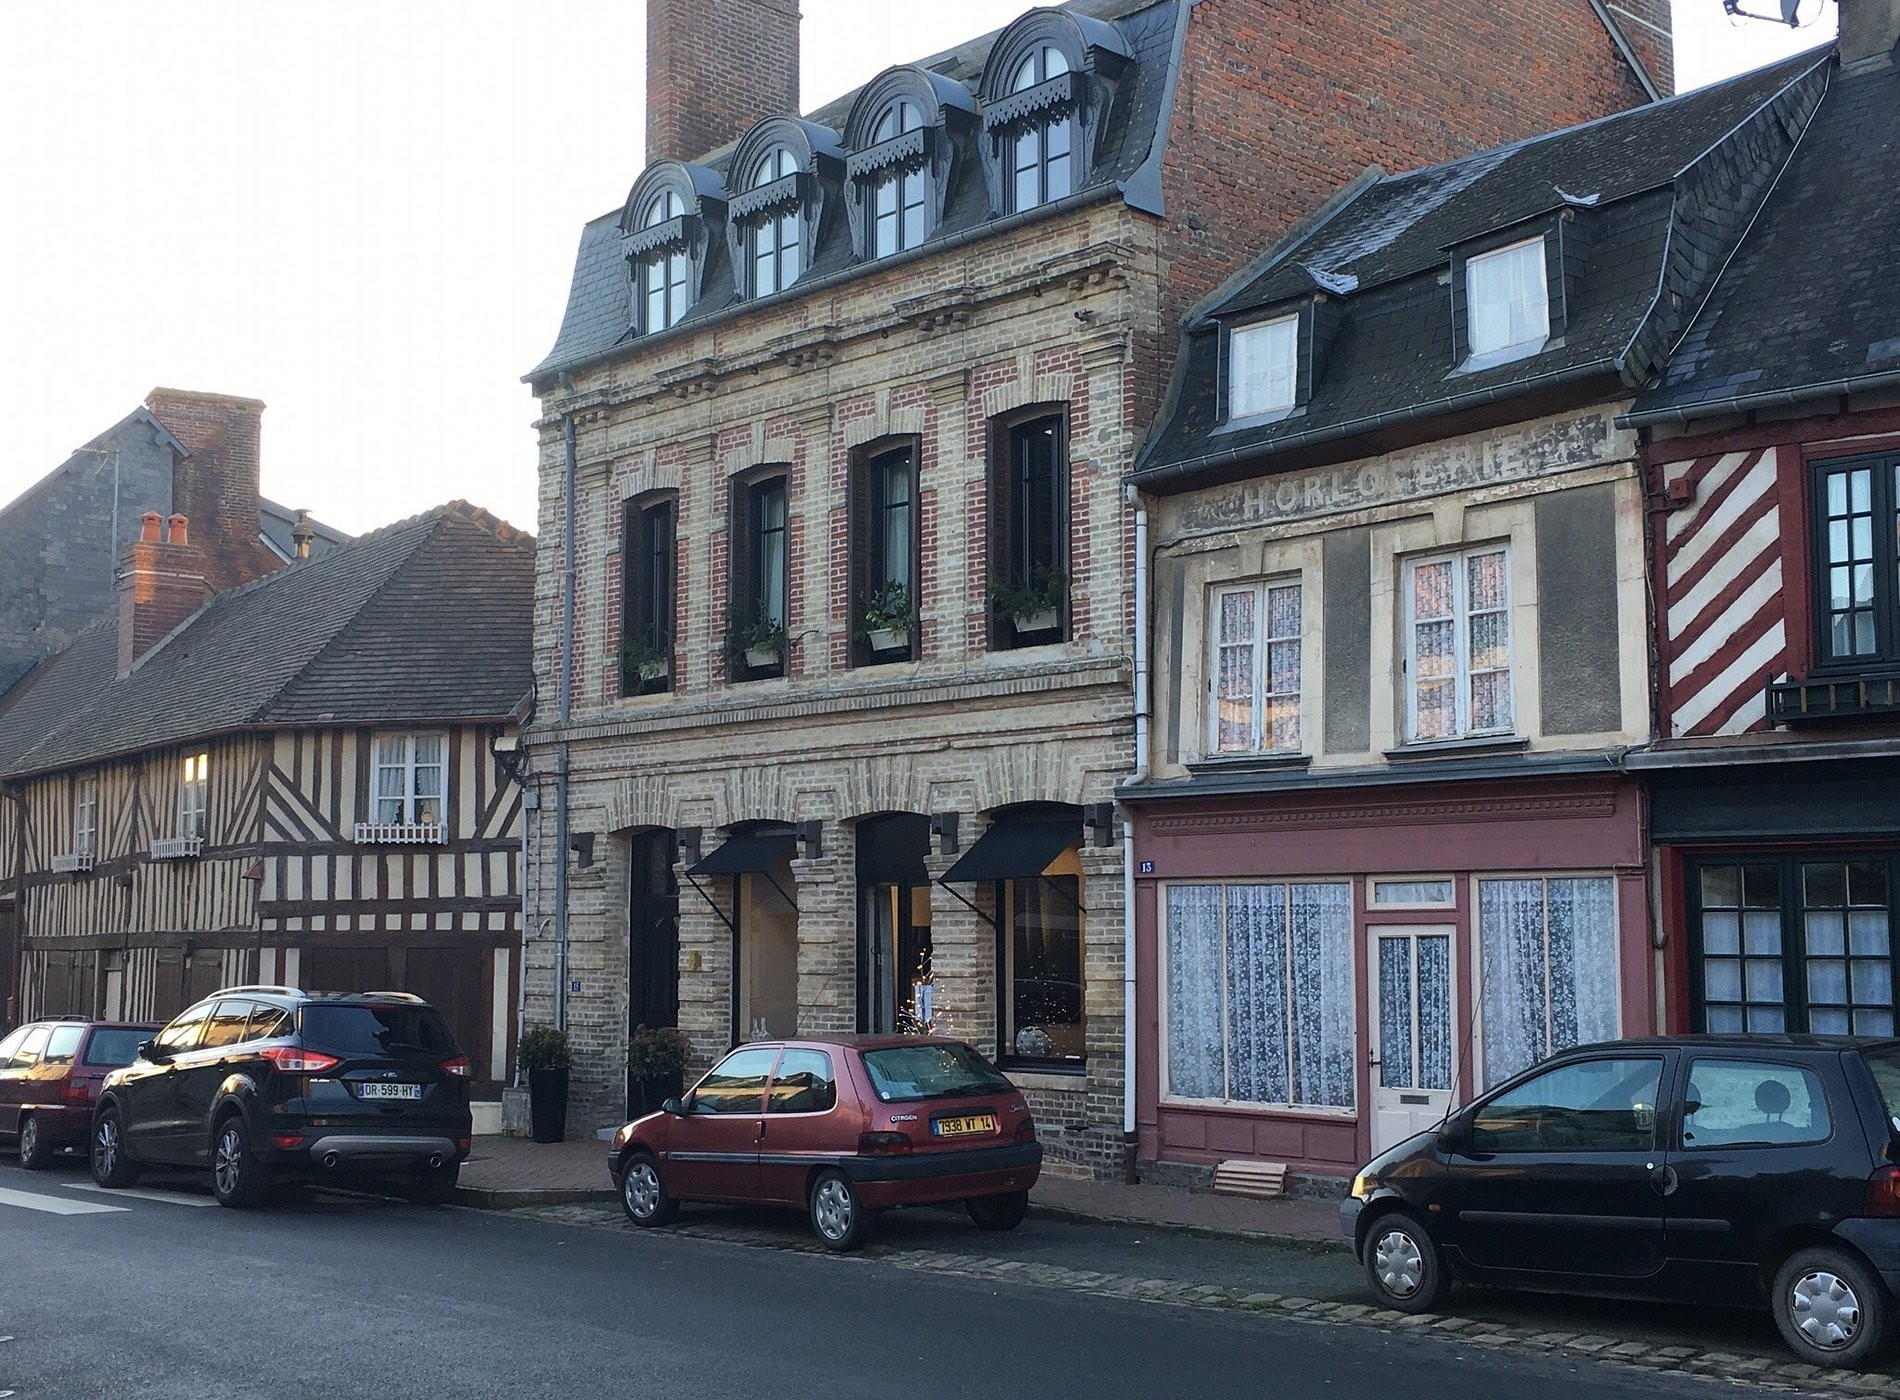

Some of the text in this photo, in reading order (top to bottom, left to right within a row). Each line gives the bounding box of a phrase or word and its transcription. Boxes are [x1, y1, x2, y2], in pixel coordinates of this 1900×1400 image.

[1142, 862, 1152, 873] 13
[938, 1119, 963, 1133] 7938
[980, 1116, 991, 1130] 14
